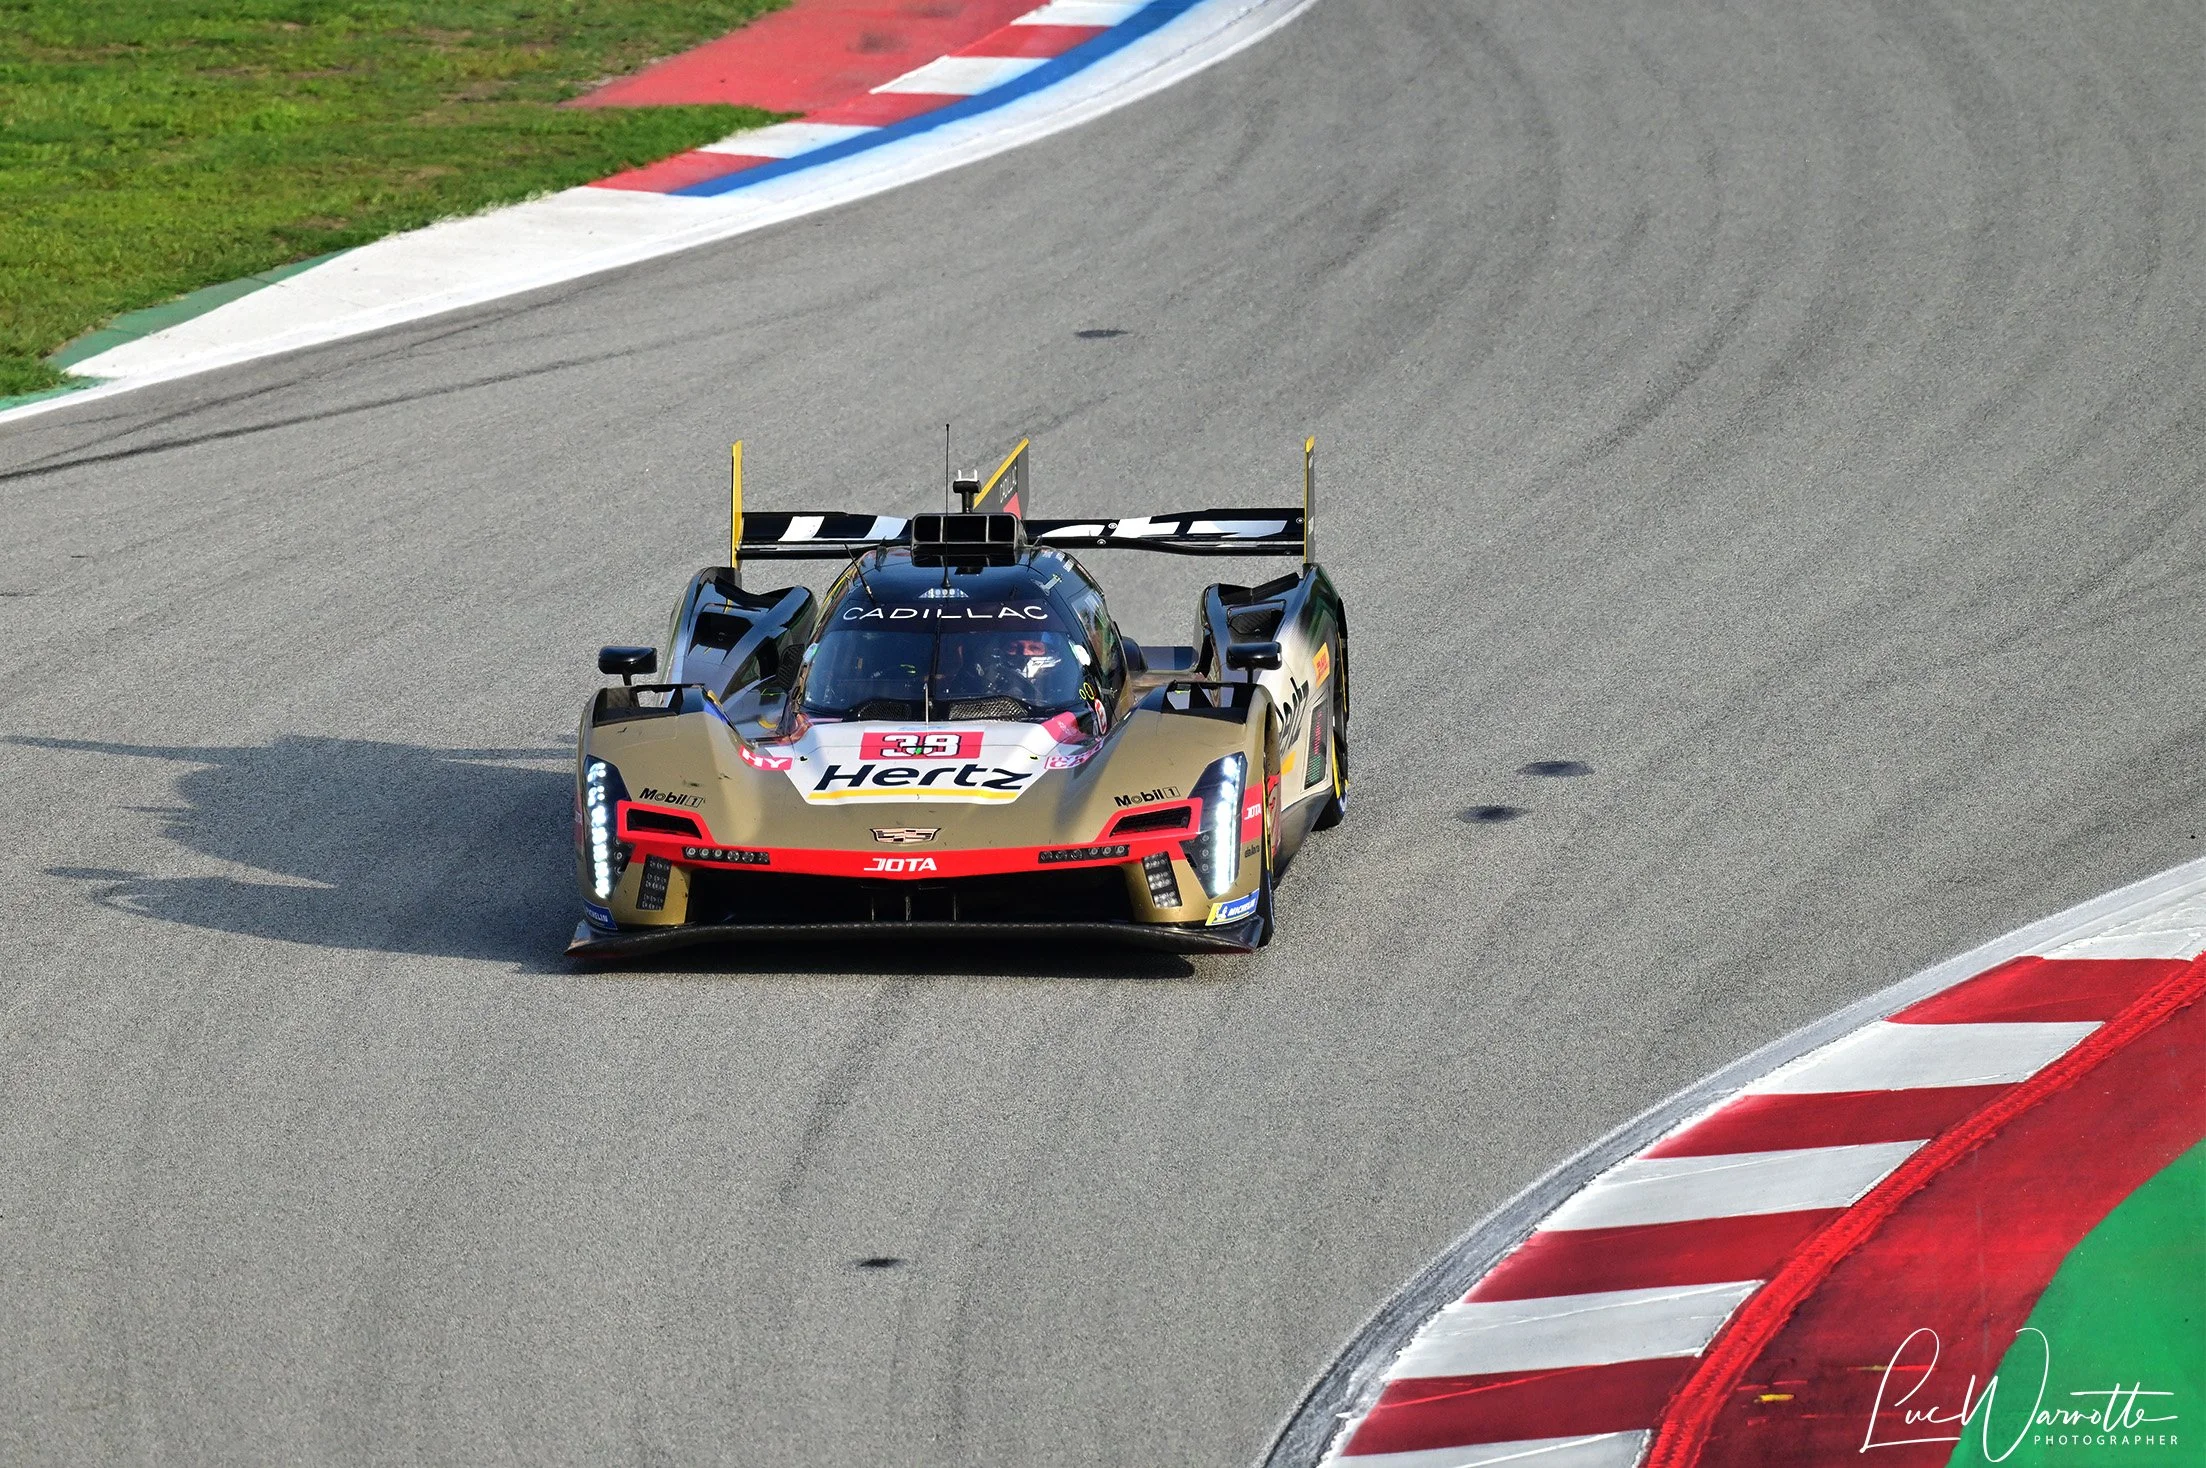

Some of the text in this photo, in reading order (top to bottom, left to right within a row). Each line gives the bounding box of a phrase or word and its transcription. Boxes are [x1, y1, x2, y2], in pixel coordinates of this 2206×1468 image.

[843, 606, 1049, 620] CADILLAC
[880, 733, 962, 758] 38
[742, 747, 790, 769] HY
[813, 763, 1033, 791] Hertz
[639, 787, 688, 806] Mobil
[1114, 788, 1165, 807] Mobil
[863, 856, 938, 873] JOTA
